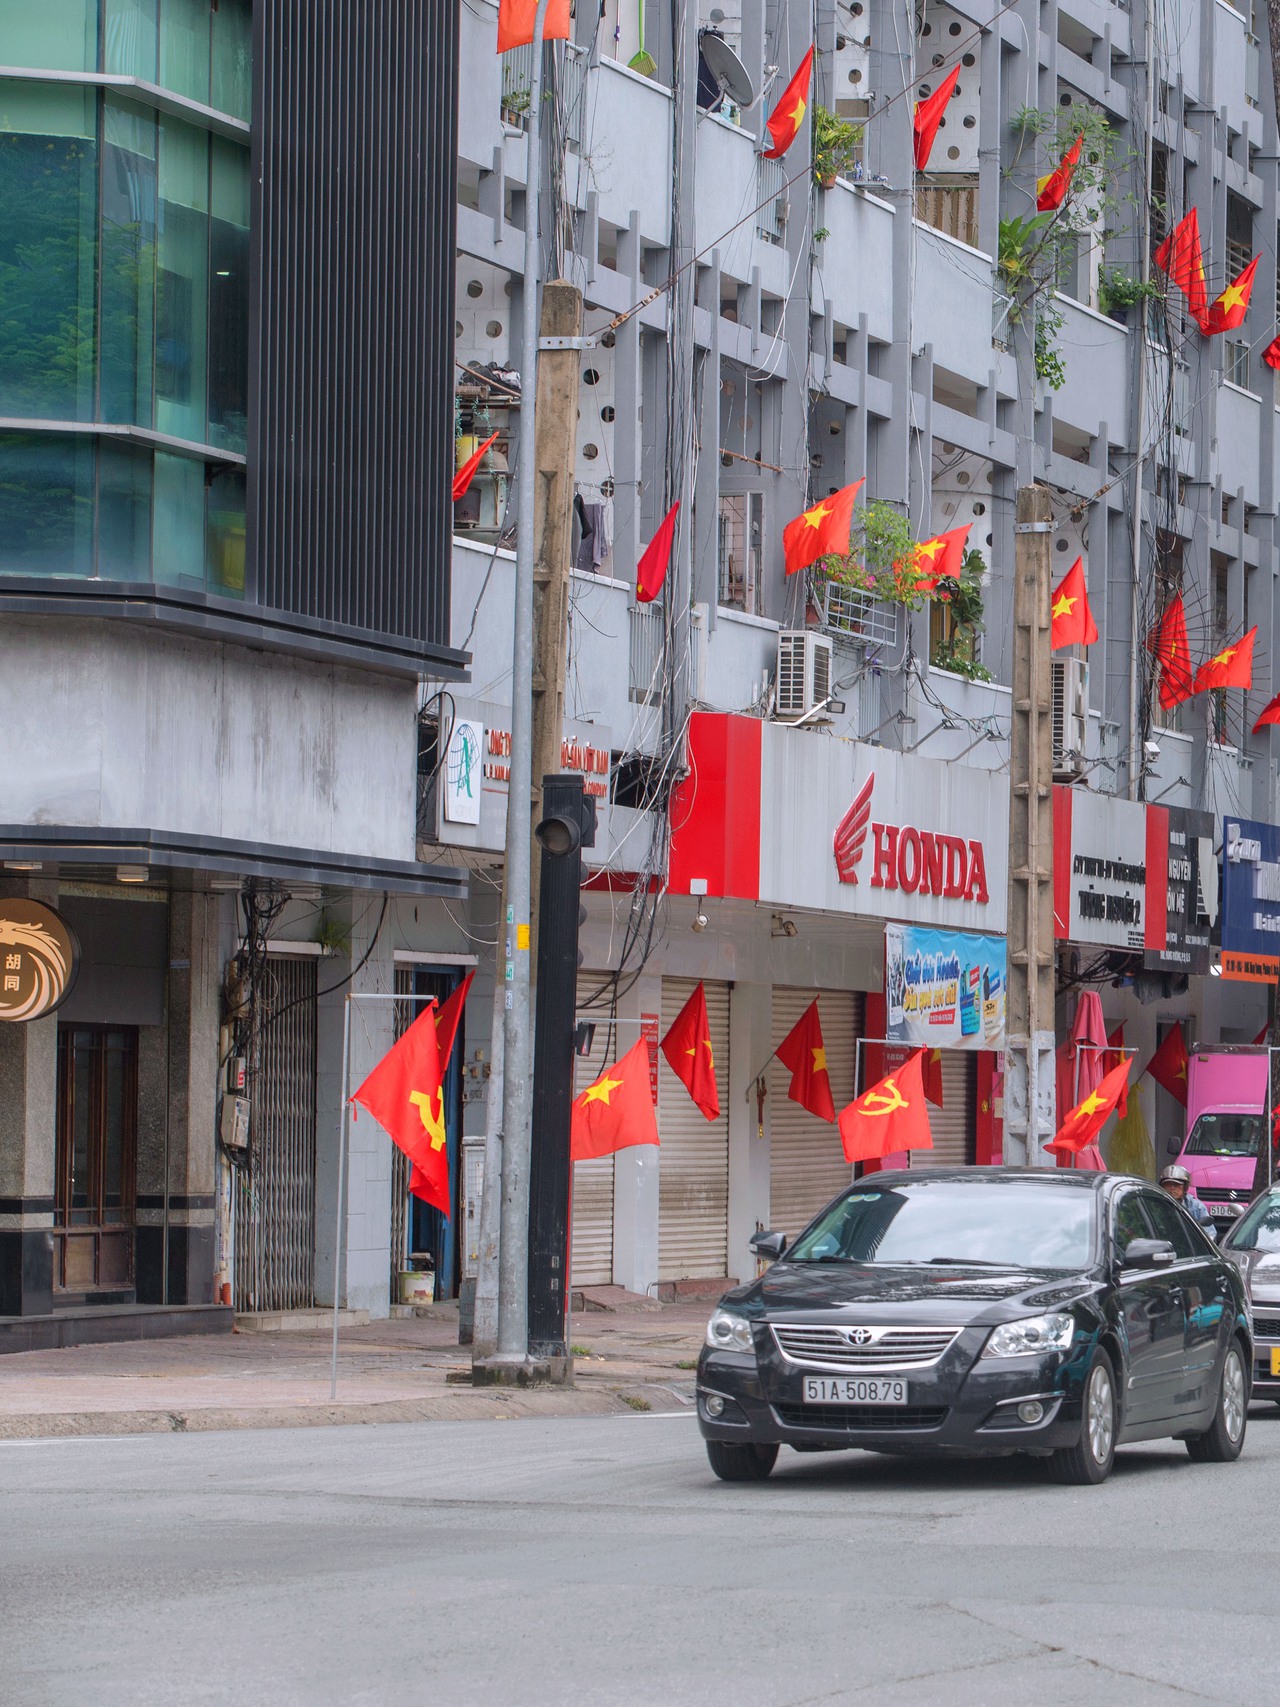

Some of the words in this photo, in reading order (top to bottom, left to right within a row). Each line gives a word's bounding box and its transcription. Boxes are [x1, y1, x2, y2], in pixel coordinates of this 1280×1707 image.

[870, 820, 990, 904] HONDA
[4, 953, 21, 991] 胡同
[808, 1380, 904, 1401] 51A-508.79
